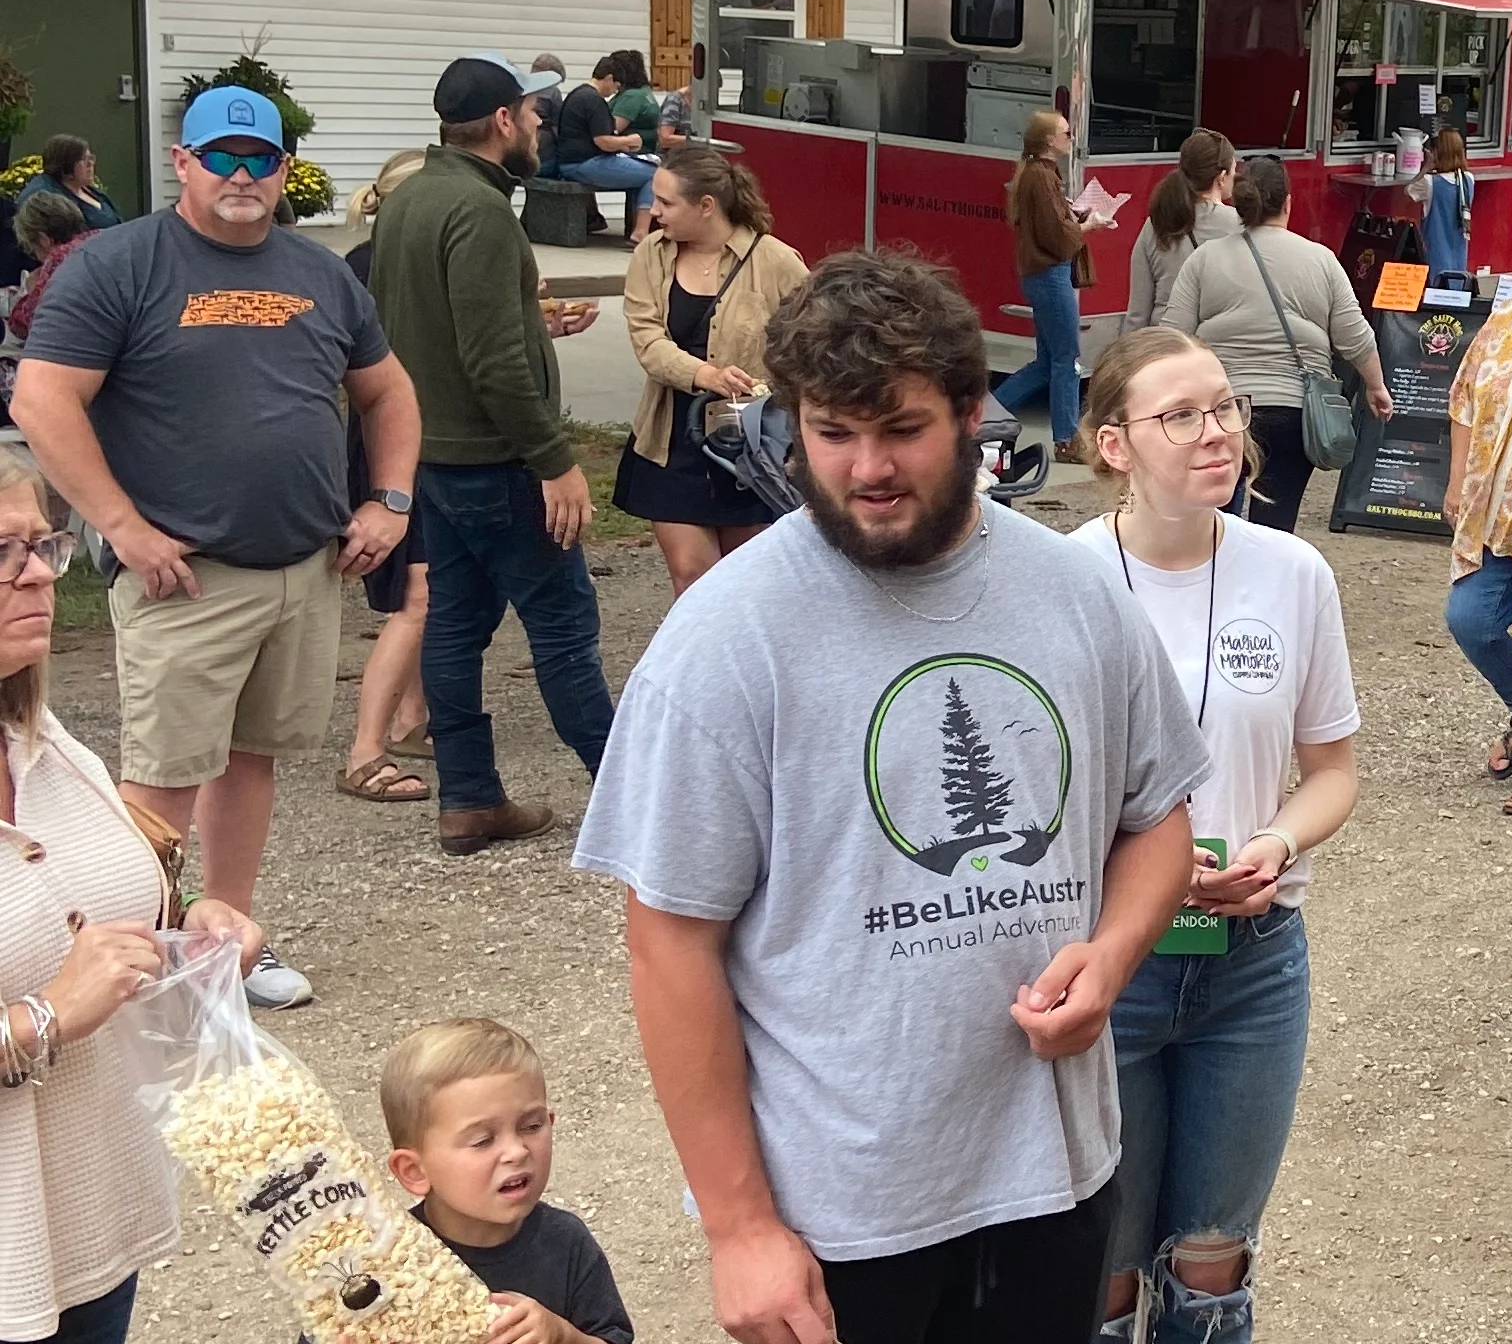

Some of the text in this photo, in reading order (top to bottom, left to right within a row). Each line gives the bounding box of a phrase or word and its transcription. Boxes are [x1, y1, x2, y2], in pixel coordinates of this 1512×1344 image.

[1467, 35, 1484, 50] PICK
[1468, 50, 1479, 64] UP
[1418, 319, 1433, 334] THE
[1432, 314, 1456, 326] SALTY
[1172, 915, 1218, 929] ENDOR
[890, 922, 984, 961] Annual
[256, 1181, 366, 1259] KETTLE CORN
